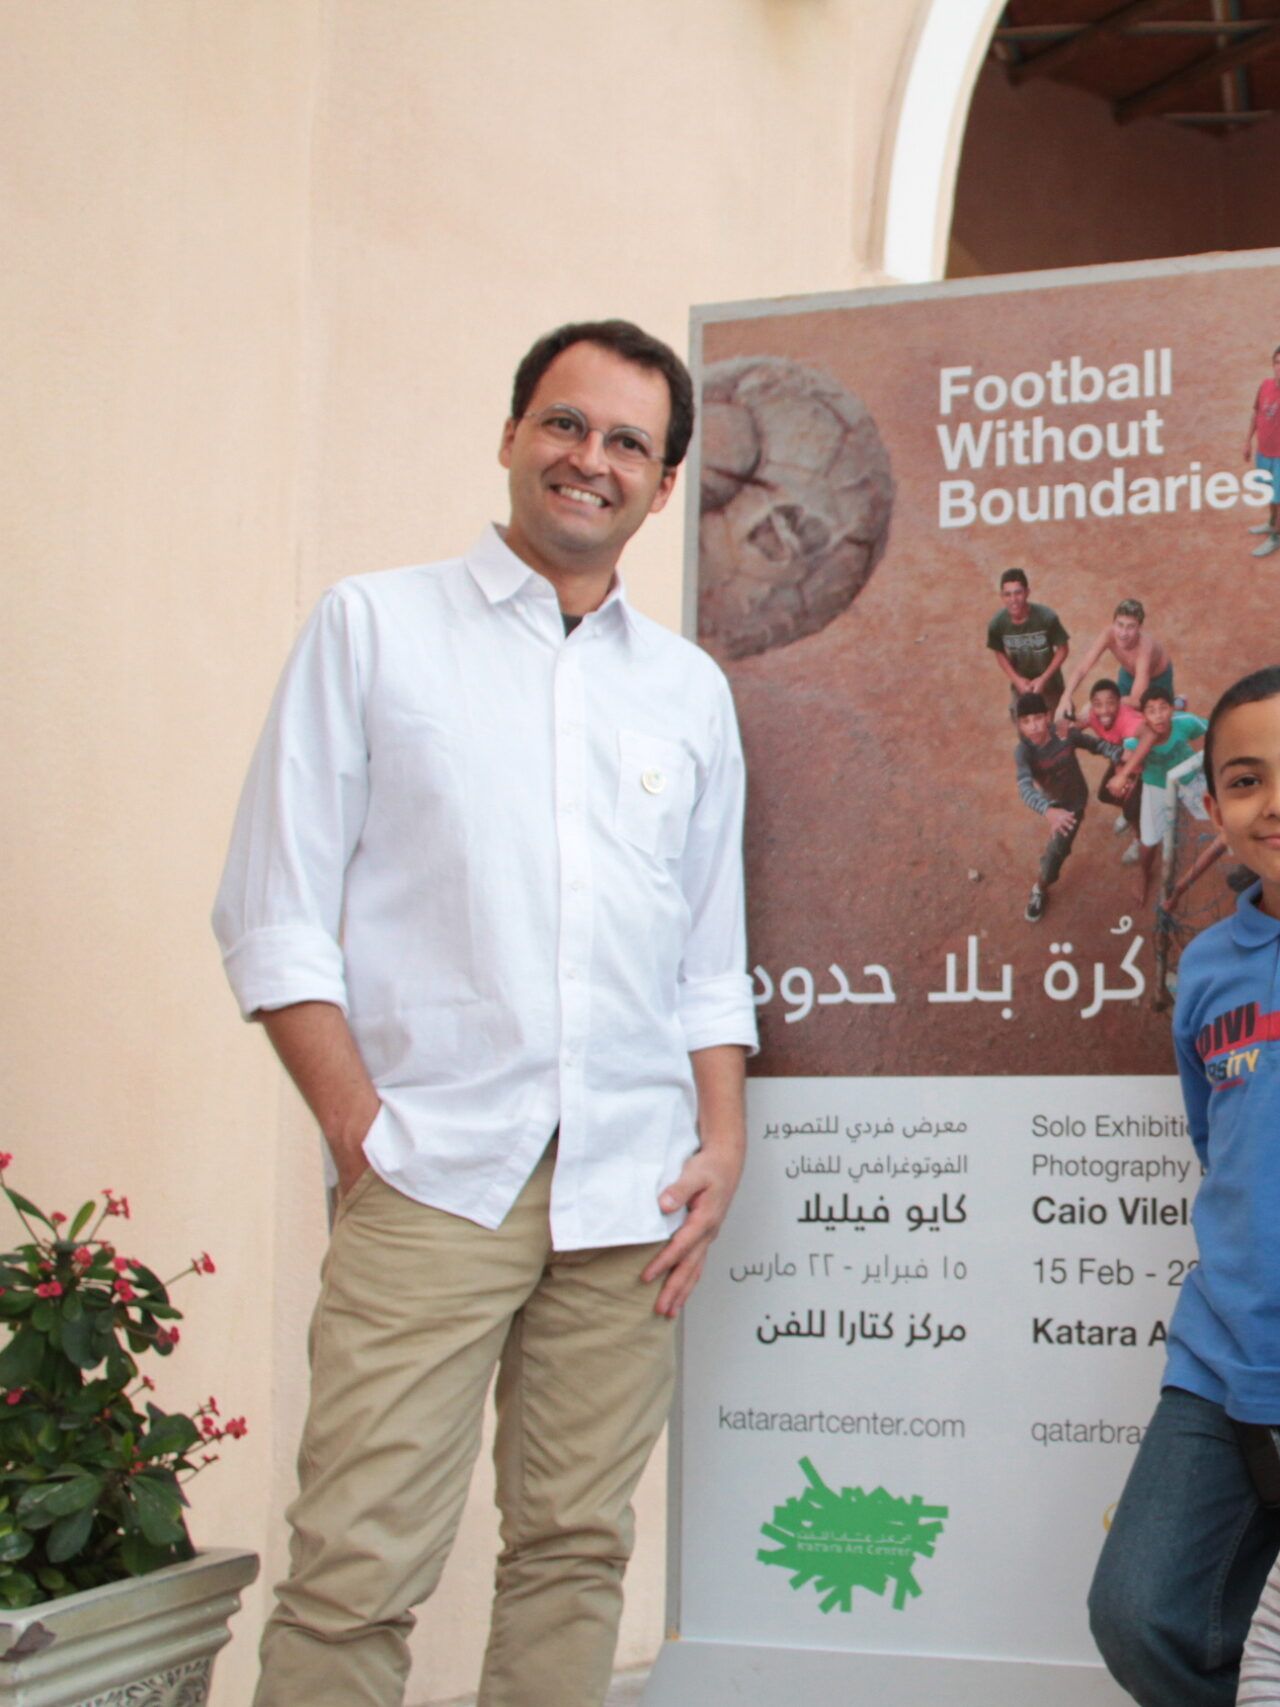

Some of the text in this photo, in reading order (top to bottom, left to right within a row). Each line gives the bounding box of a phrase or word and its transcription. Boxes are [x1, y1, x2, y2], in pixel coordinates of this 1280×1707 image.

[938, 348, 1173, 415] Football
[937, 409, 1165, 471] Without
[938, 464, 1274, 530] Boundaries
[927, 934, 1013, 1020] بلا
[753, 963, 897, 1023] حدود
[763, 1115, 968, 1143] معرض فردي للتصوير
[1031, 1115, 1188, 1138] Solo Exhibiti
[786, 1155, 968, 1183] الفوتوغرافي للفنان
[1032, 1154, 1191, 1183] Photography
[798, 1193, 968, 1232] كايو فيليلا
[1031, 1196, 1193, 1226] Caio Vilel
[729, 1253, 797, 1283] مارس
[862, 1255, 929, 1285] فبراير
[1033, 1258, 1067, 1285] 15
[1078, 1258, 1135, 1286] Feb
[757, 1309, 967, 1348] مركز كتارا للفن
[1032, 1317, 1137, 1346] Katara
[718, 1405, 966, 1438] kataraartcenter.com
[1031, 1417, 1145, 1447] qatarbra
